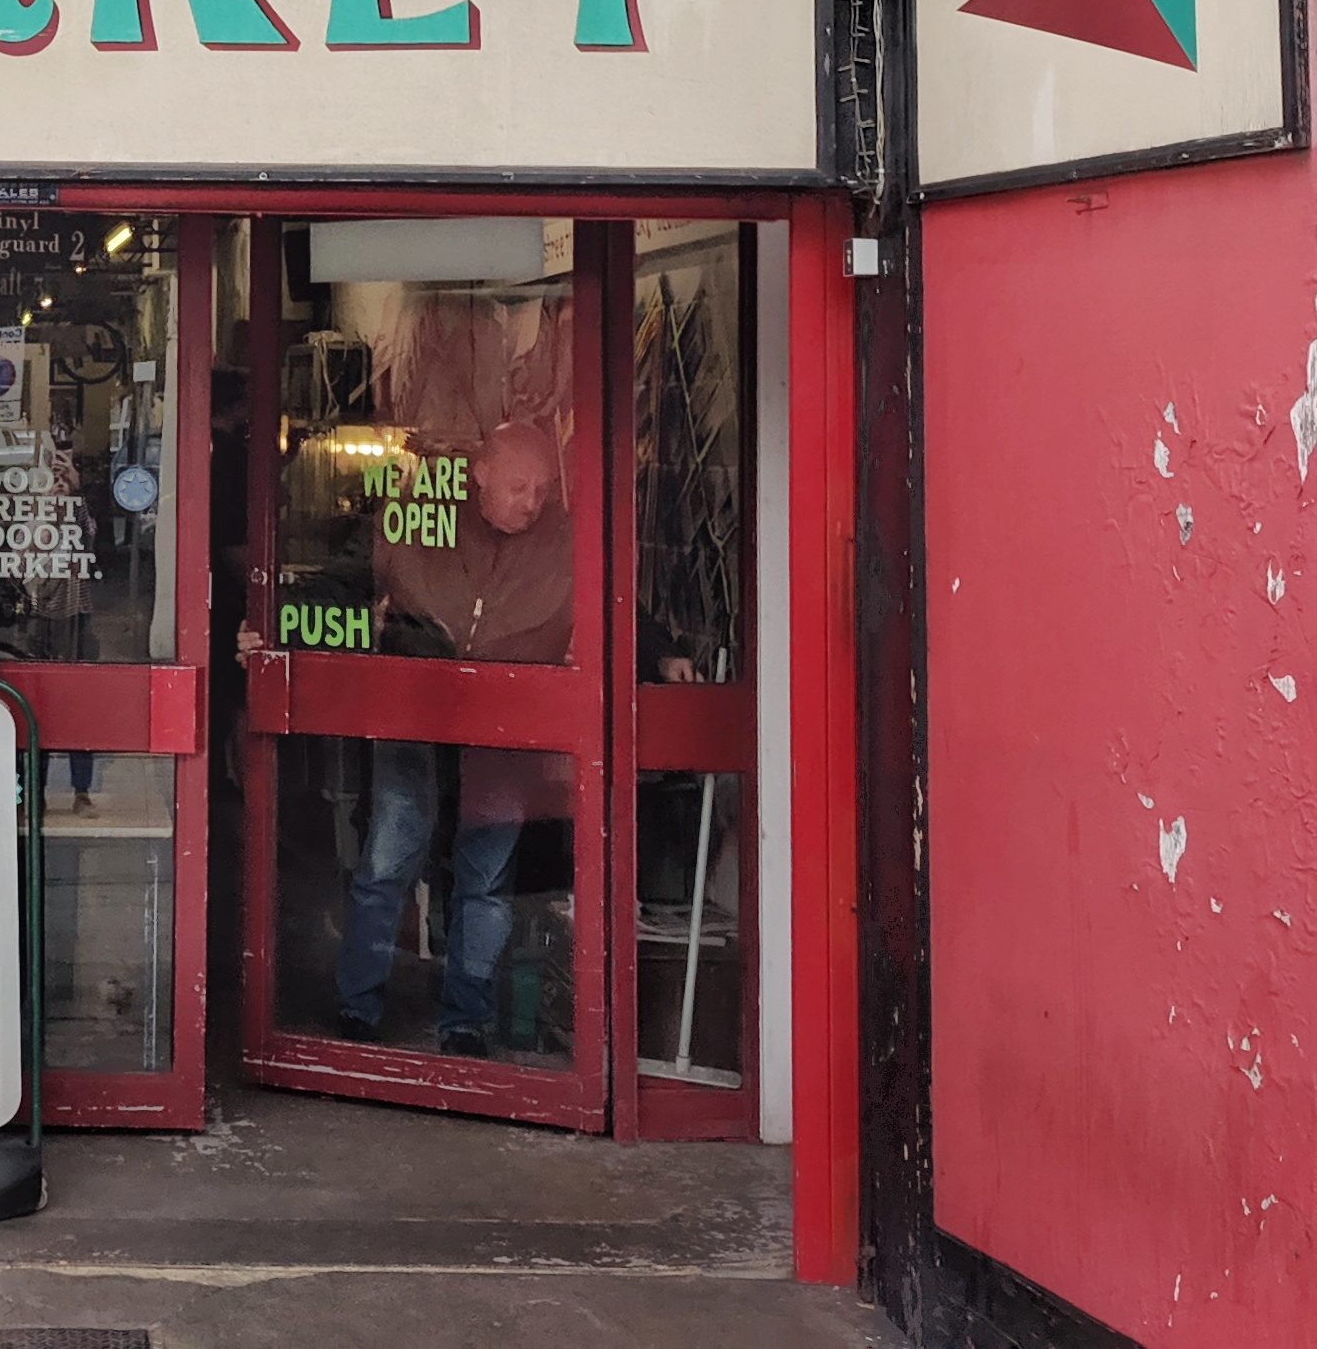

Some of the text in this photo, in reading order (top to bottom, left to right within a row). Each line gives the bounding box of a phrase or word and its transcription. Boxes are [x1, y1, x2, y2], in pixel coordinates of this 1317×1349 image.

[69, 230, 85, 261] 2
[363, 456, 468, 501] WE ARE
[383, 502, 457, 549] OPEN
[280, 604, 370, 649] PUSH
